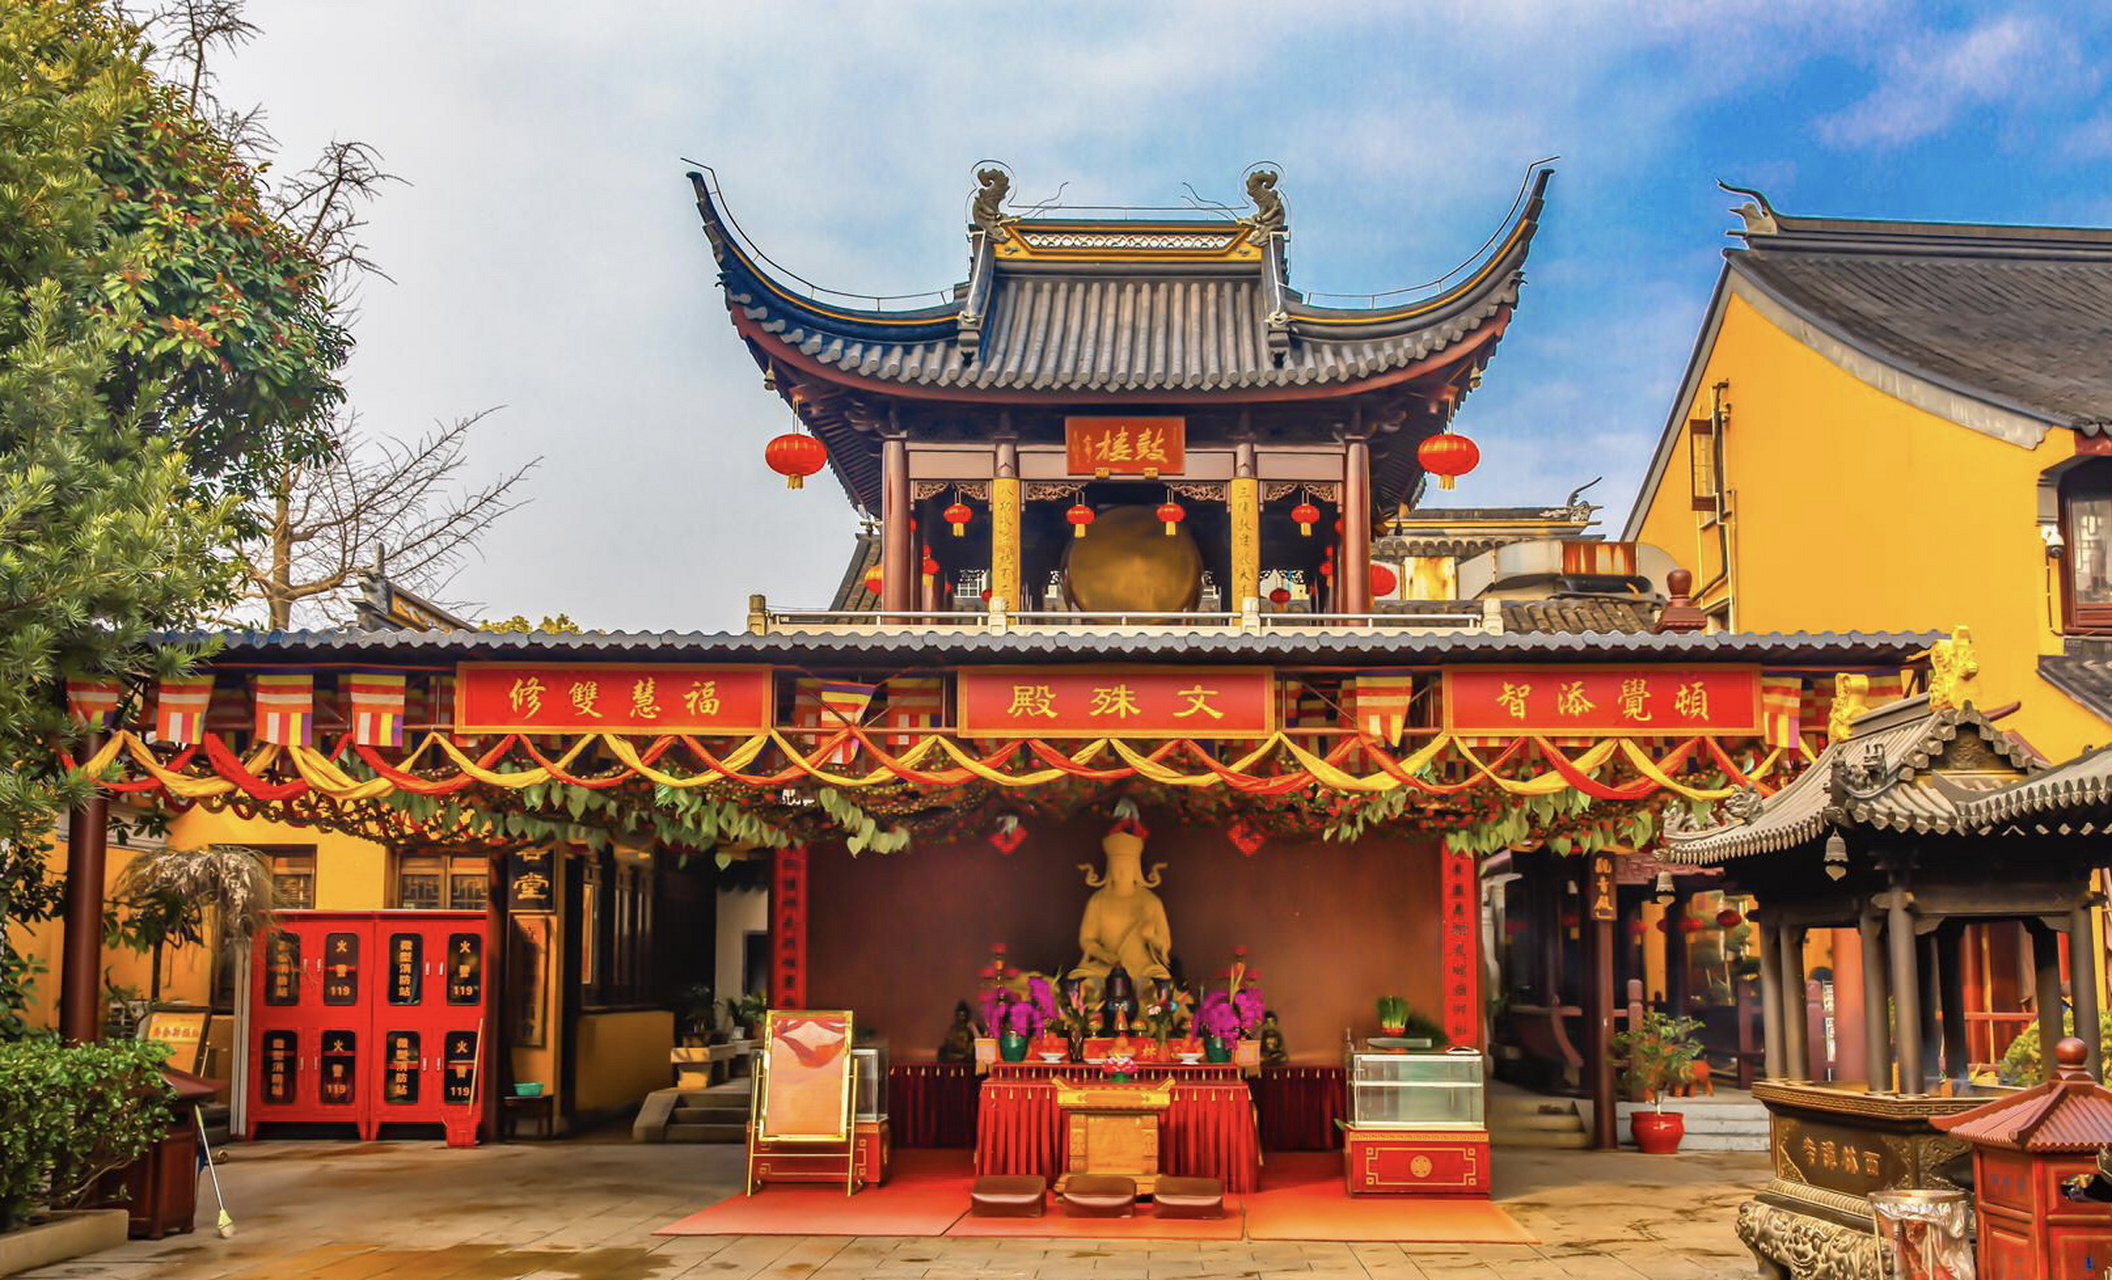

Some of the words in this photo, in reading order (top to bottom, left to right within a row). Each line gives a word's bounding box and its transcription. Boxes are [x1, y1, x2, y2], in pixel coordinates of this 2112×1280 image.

[509, 677, 720, 719] 福慧雙修
[1007, 684, 1224, 718] 文殊殿
[336, 940, 347, 978] 火警
[398, 940, 413, 997] 微型消防站
[459, 940, 471, 978] 火警
[330, 986, 350, 996] 119
[453, 985, 473, 996] 119
[271, 1038, 284, 1096] 微型消防站
[332, 1040, 344, 1077] 火警
[396, 1037, 408, 1095] 微型消防站
[456, 1040, 468, 1078] 火警
[326, 1084, 346, 1095] 119
[450, 1086, 470, 1096] 119
